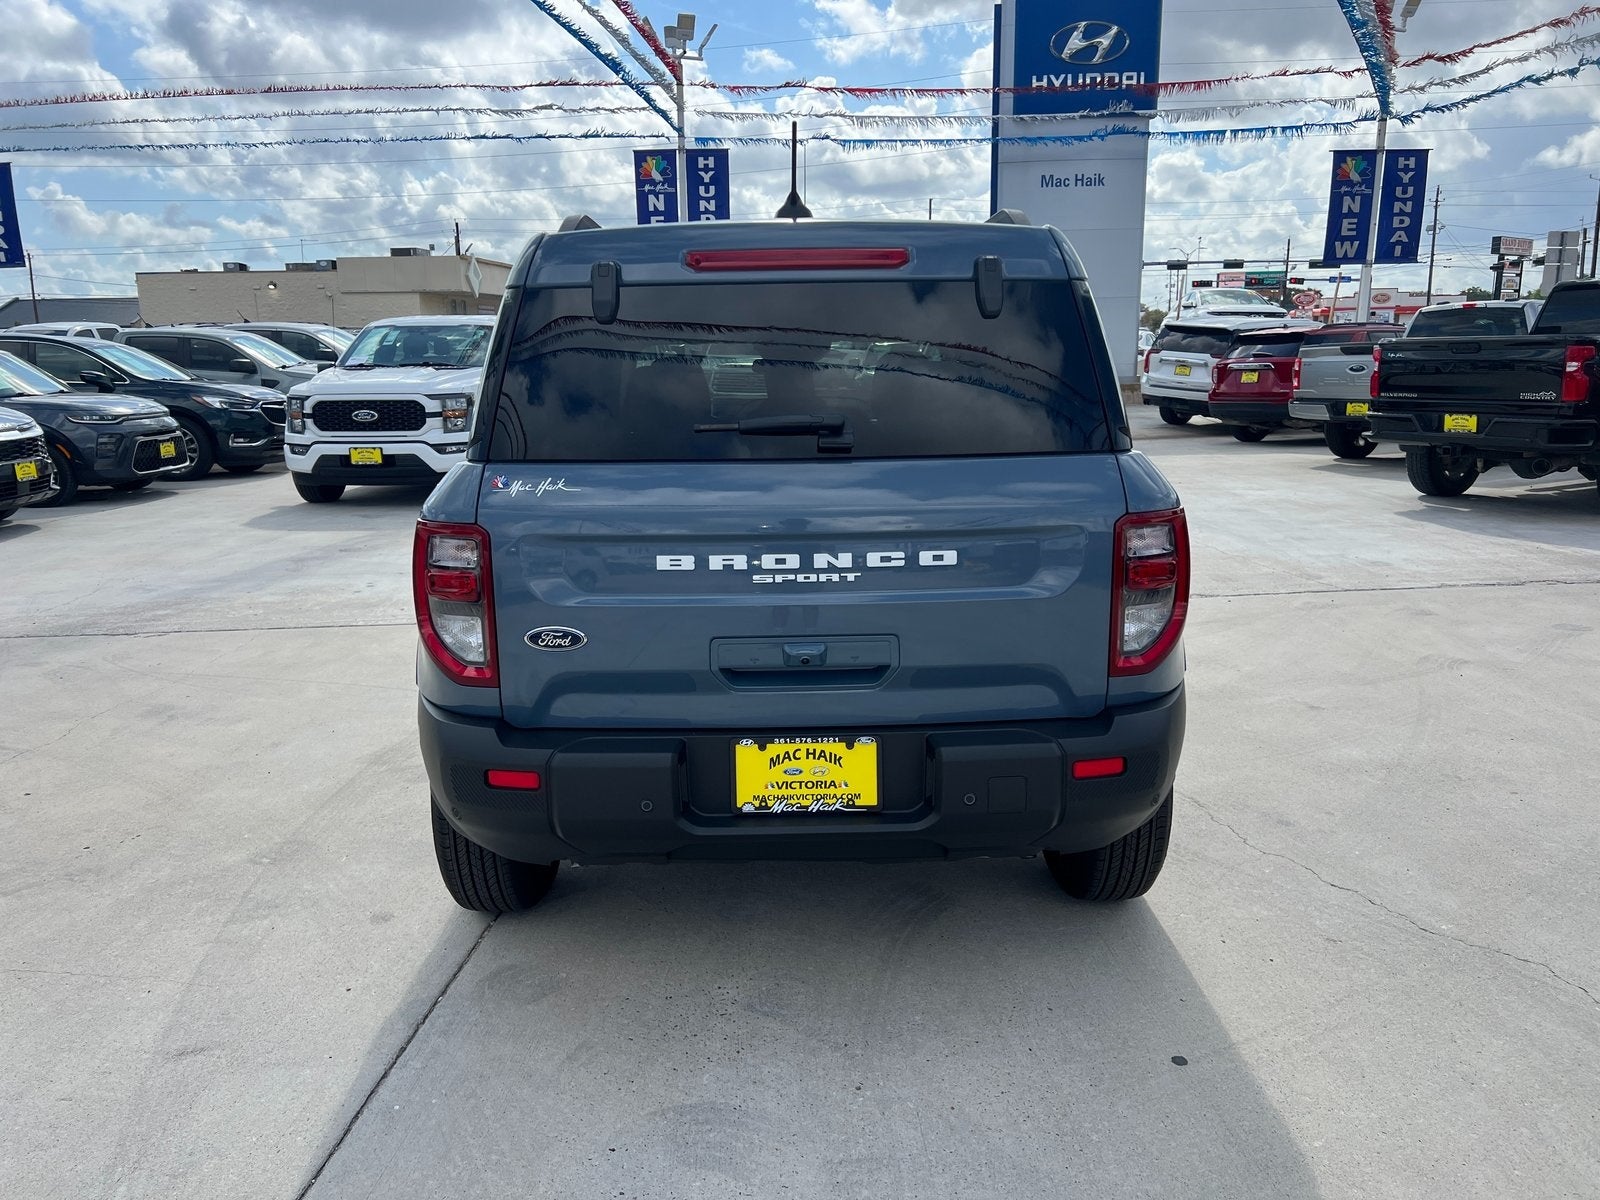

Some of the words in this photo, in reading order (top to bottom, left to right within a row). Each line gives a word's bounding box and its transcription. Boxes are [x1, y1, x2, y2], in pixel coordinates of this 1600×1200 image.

[1031, 71, 1145, 91] HYUNDAI
[697, 156, 716, 221] HYUND
[1040, 174, 1070, 188] Mac
[1074, 173, 1105, 187] Haik
[1389, 156, 1416, 257] HYUNDAI
[1334, 195, 1360, 259] NEW
[509, 479, 535, 497] Mac
[535, 477, 572, 497] Haik
[656, 550, 958, 571] BRONCO
[752, 572, 861, 583] SPORT
[537, 631, 572, 647] Ford
[769, 748, 801, 770] MAC
[805, 748, 843, 769] HAIK
[775, 780, 838, 790] VICTORIA
[752, 793, 861, 802] MACHAIKVICTORIA.COM
[770, 799, 803, 813] Mac
[807, 798, 846, 812] Haik
